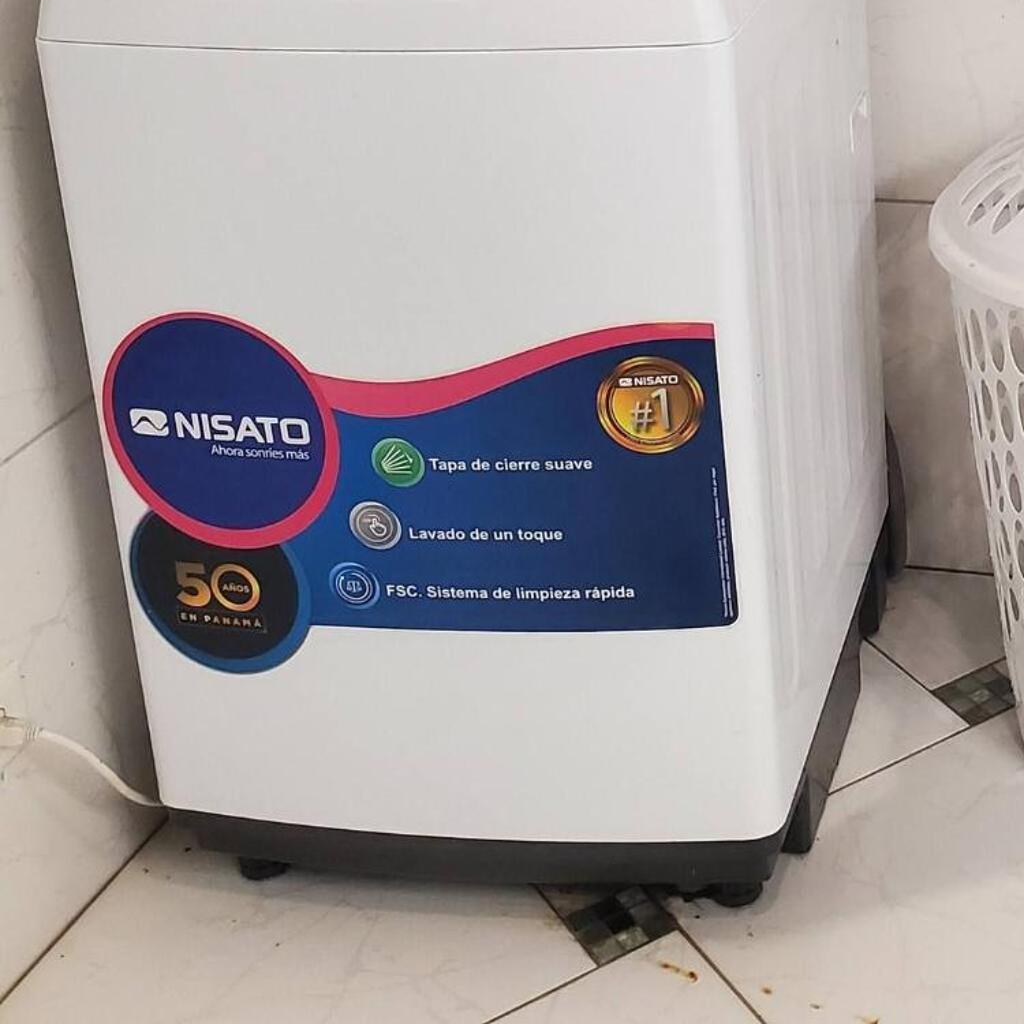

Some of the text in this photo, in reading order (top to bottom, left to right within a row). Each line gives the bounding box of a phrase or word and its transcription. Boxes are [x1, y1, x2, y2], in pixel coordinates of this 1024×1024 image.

[634, 375, 678, 386] NISATO
[631, 388, 670, 432] #1
[174, 411, 311, 445] NISATO
[211, 445, 244, 457] Ahora
[286, 448, 310, 460] más
[428, 458, 593, 473] Tapa de cierre suave
[408, 527, 563, 543] Lavado de un toque
[175, 561, 260, 612] 50
[222, 582, 250, 593] AÑOS
[386, 584, 634, 602] FSC. Sistema de limpieza rápida
[180, 612, 197, 622] EN
